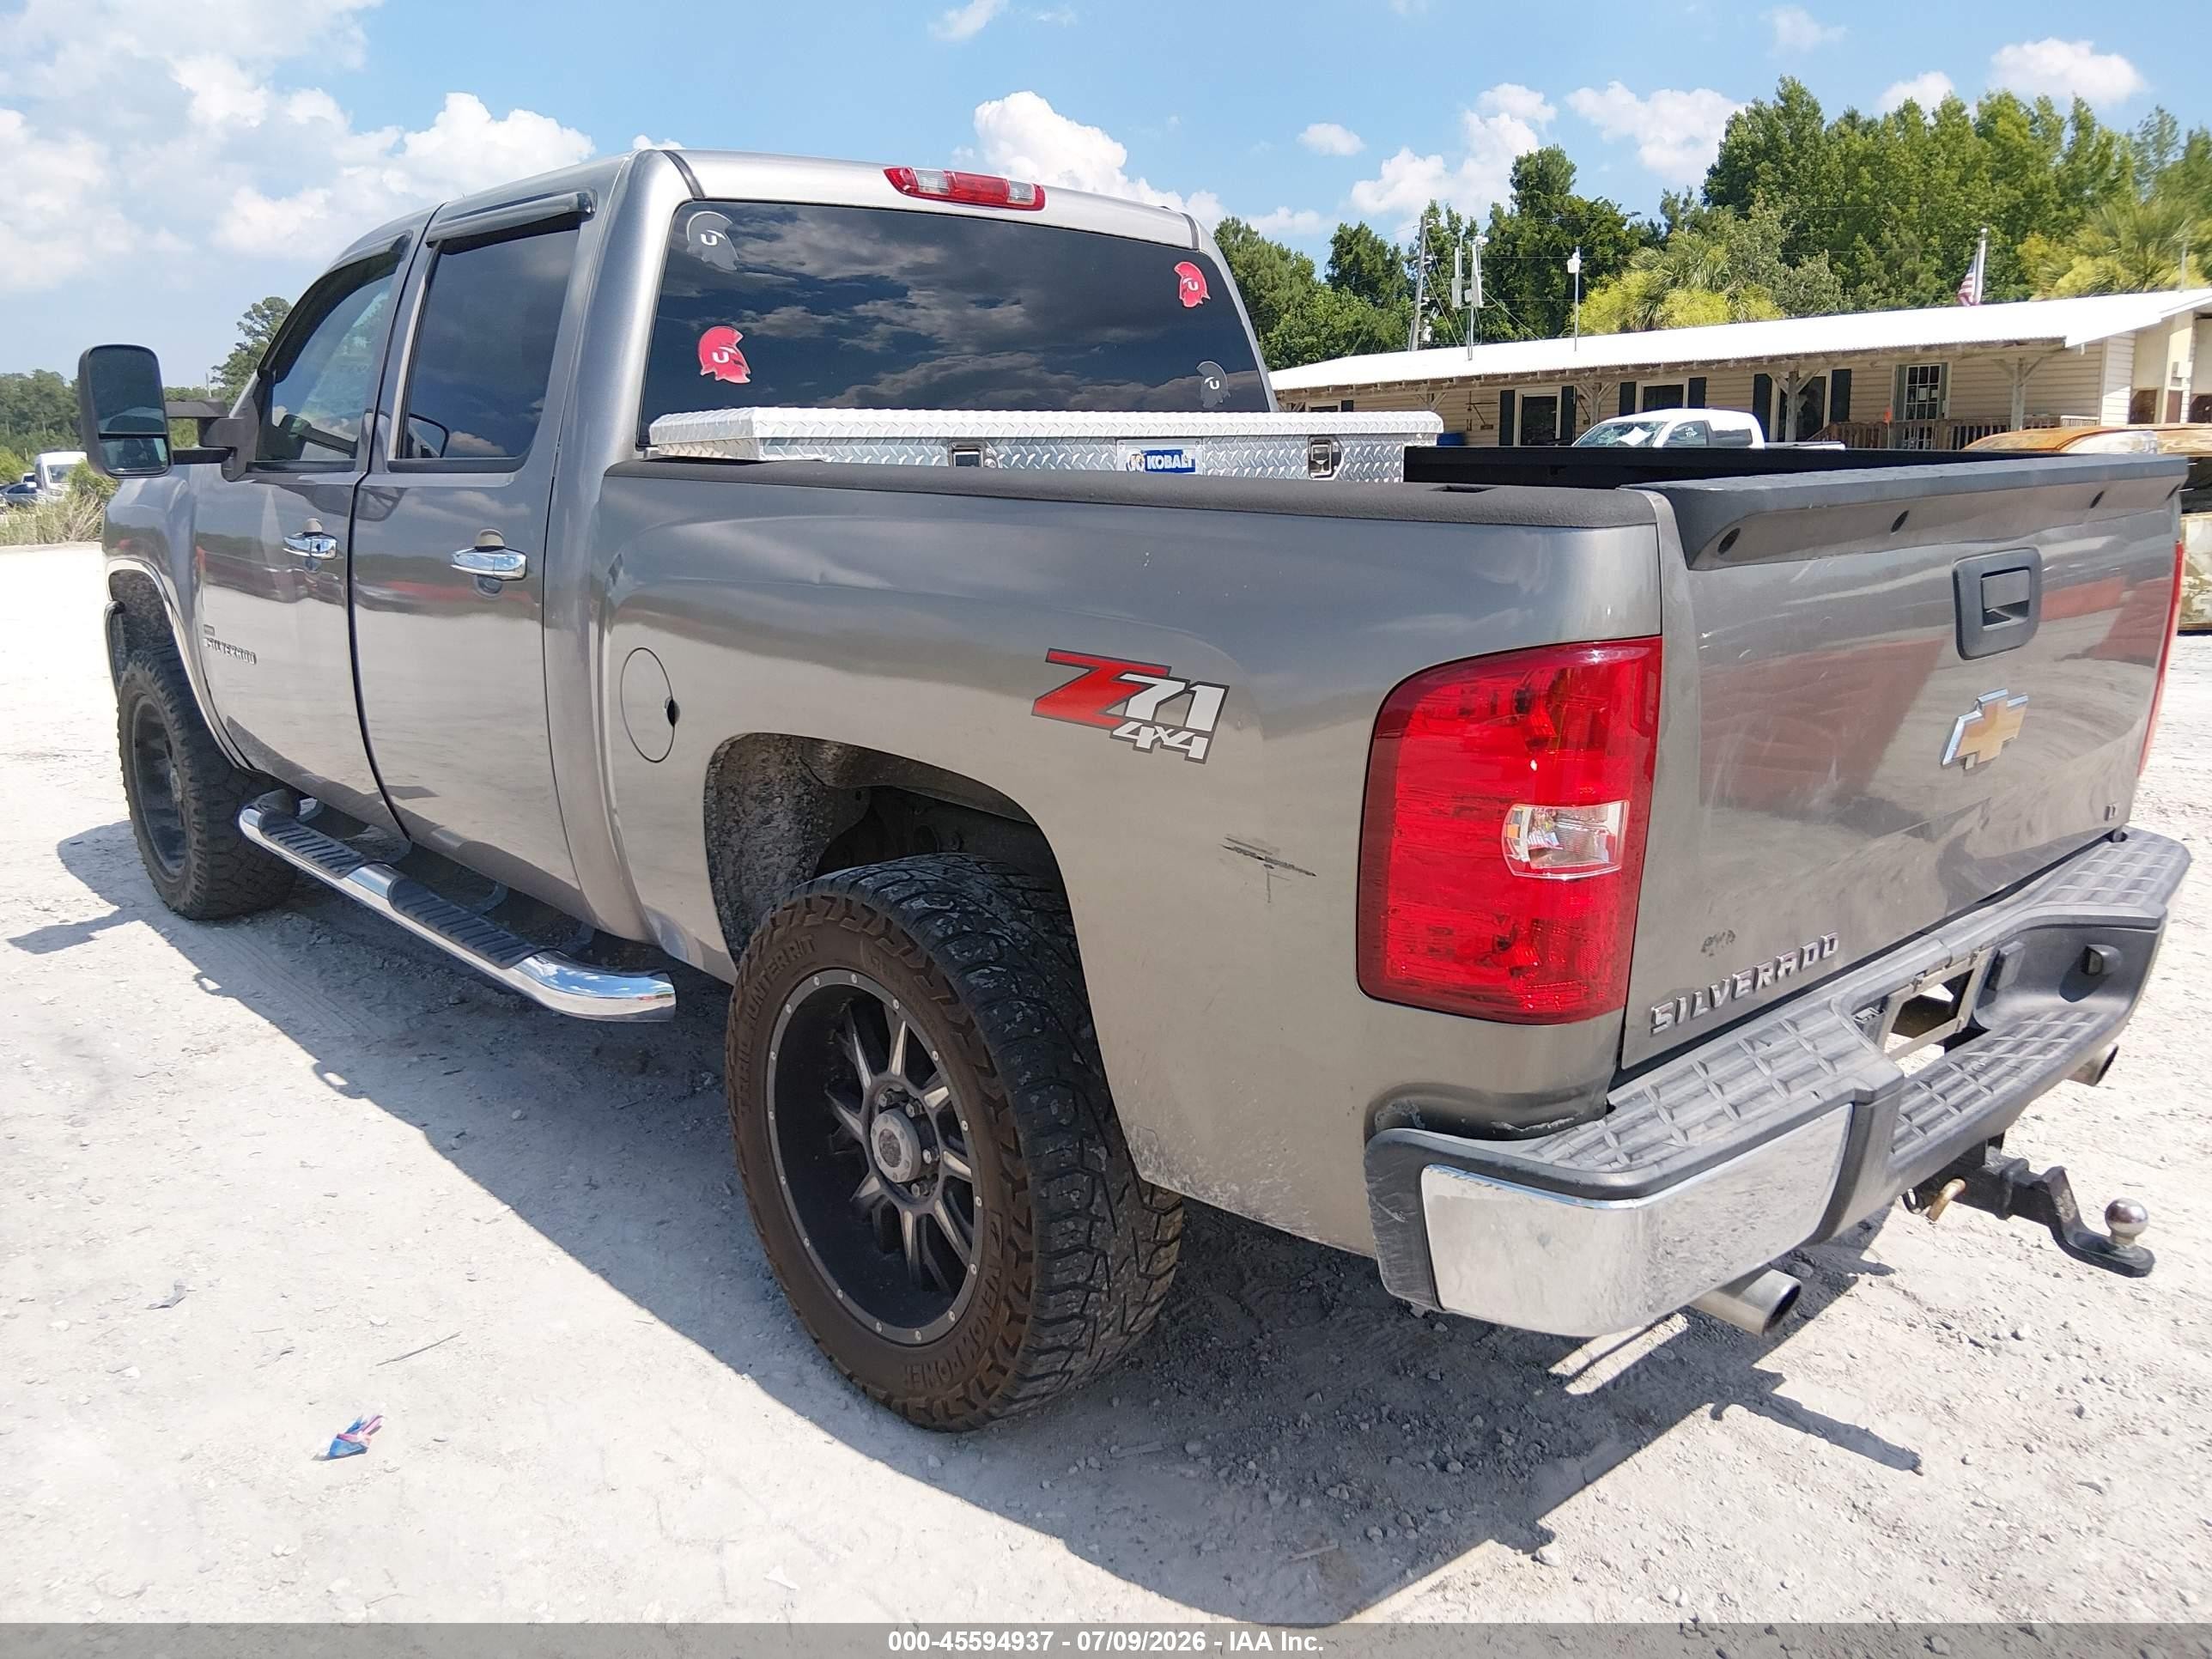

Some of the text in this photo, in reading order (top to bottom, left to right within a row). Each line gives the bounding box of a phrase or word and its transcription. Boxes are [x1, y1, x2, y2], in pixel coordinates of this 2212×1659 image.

[1146, 453, 1194, 470] KOBALT
[1031, 648, 1230, 732] Z71
[1650, 933, 1839, 1036] SILVERADO
